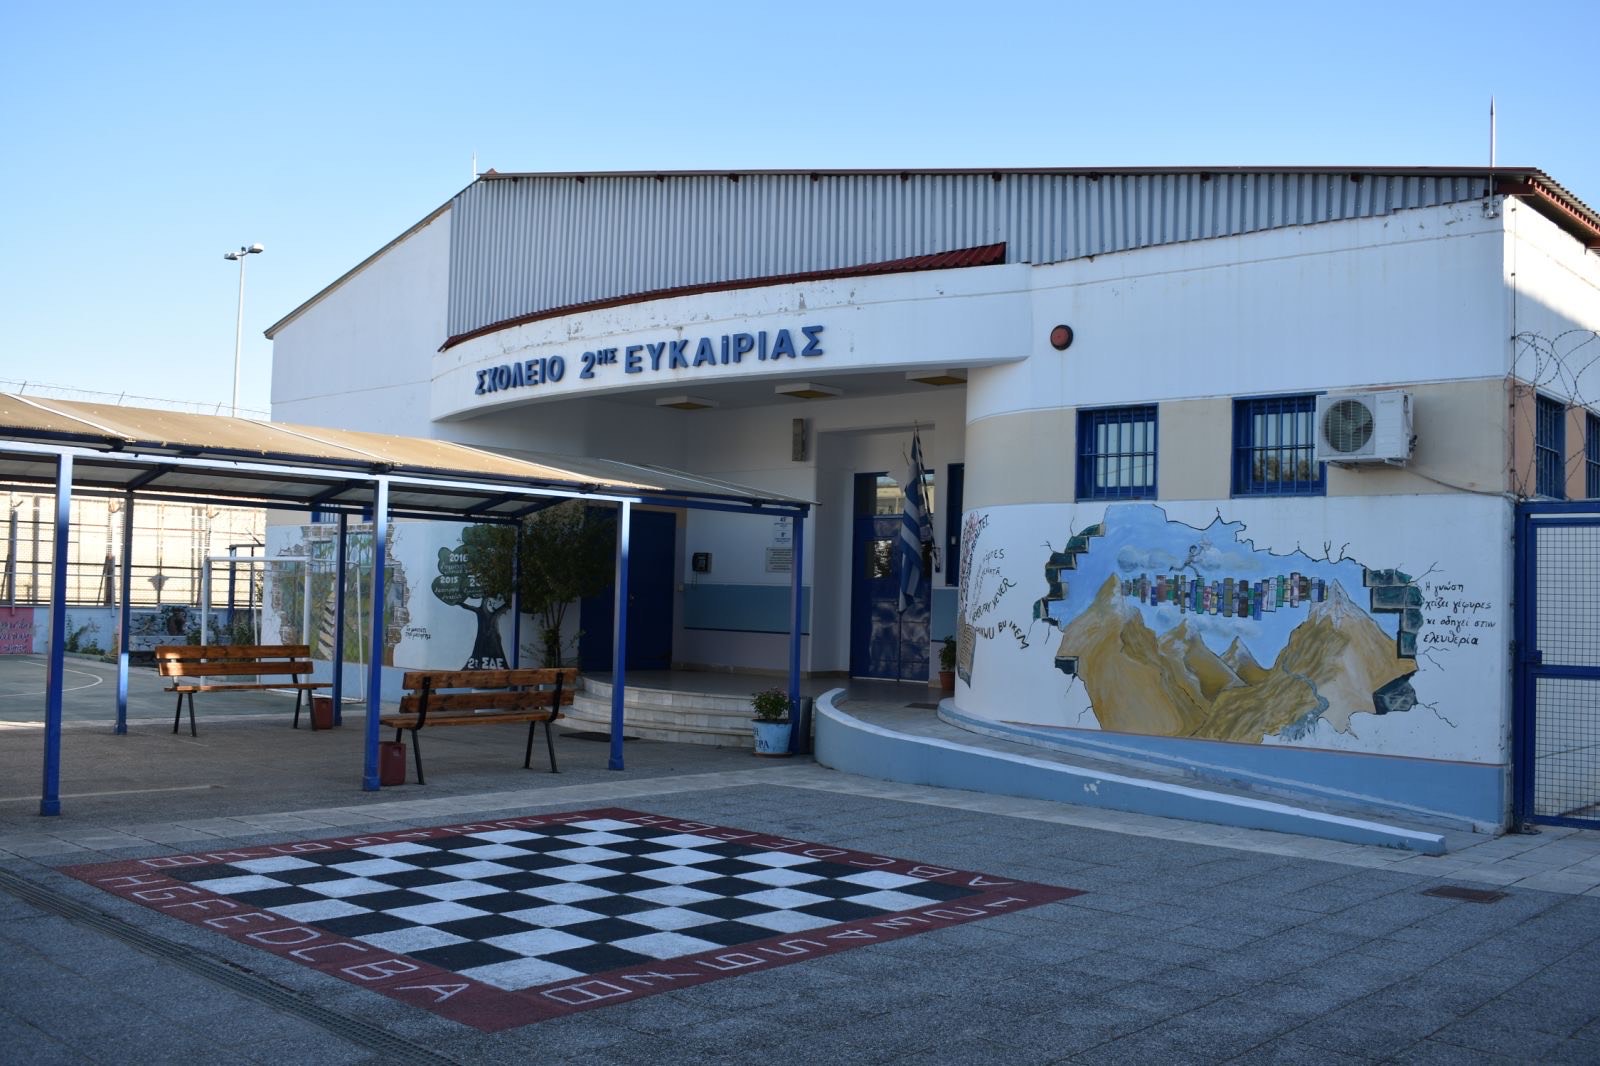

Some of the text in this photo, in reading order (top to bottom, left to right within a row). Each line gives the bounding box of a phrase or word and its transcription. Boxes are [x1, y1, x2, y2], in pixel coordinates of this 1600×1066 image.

[475, 355, 565, 395] ΣΧΟΛΕΙΟ
[624, 325, 824, 374] ΕΥΚΑΙΡΙΑΣ
[1425, 580, 1464, 597] Η γνώση
[1423, 630, 1479, 648] ελευθερία
